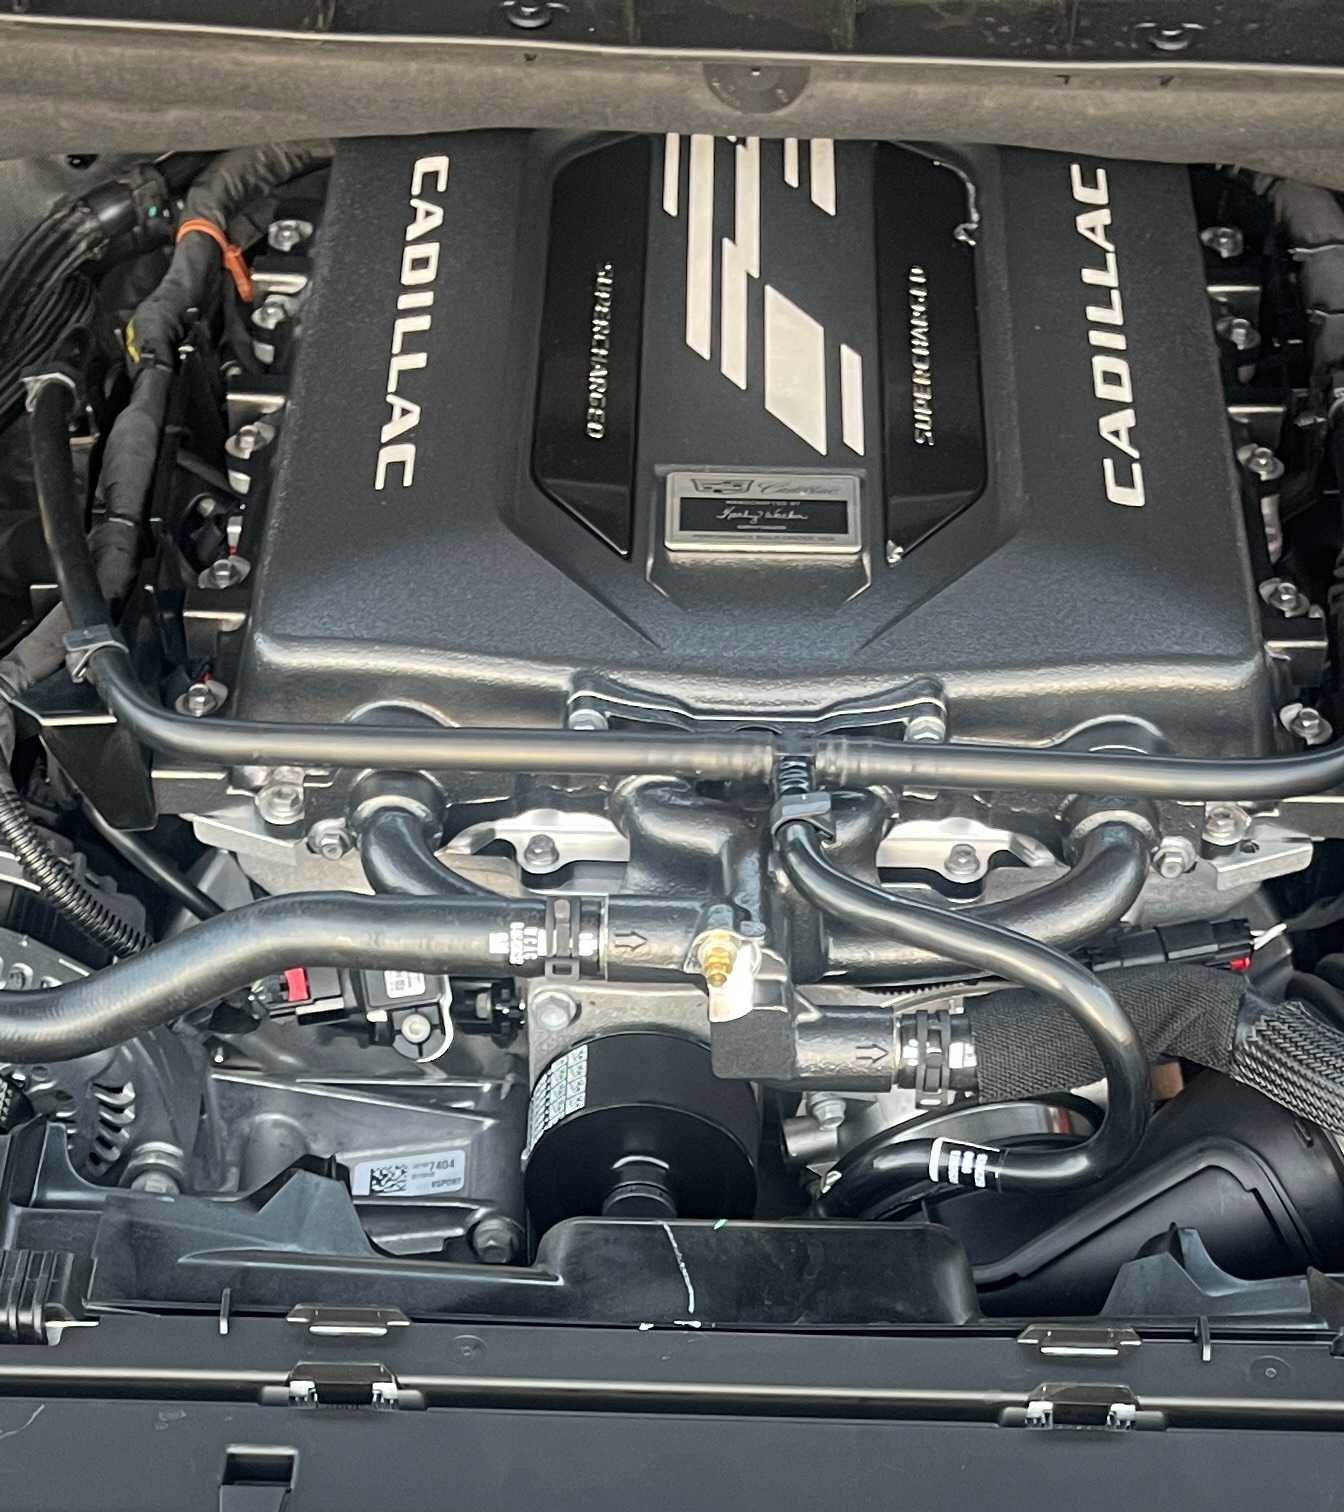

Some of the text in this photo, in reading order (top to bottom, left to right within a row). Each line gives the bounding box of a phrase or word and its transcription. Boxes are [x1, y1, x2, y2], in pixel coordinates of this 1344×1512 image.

[374, 155, 450, 491] CADILLAC
[585, 263, 615, 440] SUPERCHARGED
[907, 264, 936, 447] SUPERCHARGED
[1069, 162, 1146, 508] CADILLAC
